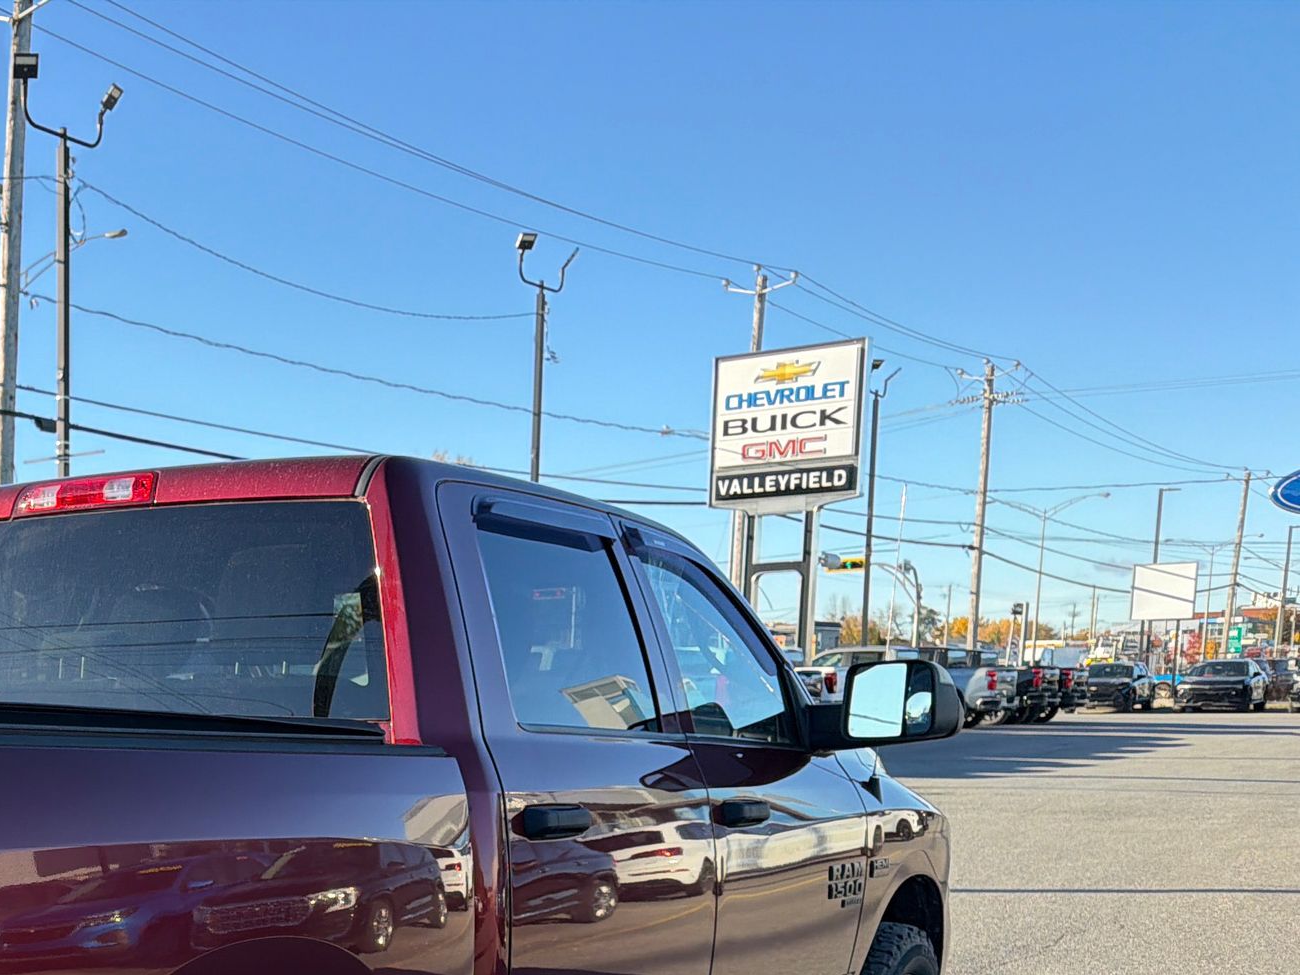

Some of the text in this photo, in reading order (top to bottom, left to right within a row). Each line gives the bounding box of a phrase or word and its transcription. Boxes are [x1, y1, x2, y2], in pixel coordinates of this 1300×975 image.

[725, 381, 850, 411] CHEVROLET
[722, 406, 848, 437] BUICK
[742, 434, 827, 462] GMC
[717, 469, 847, 496] VALLEYFIELD
[828, 862, 864, 881] RAM
[828, 879, 865, 900] 1500
